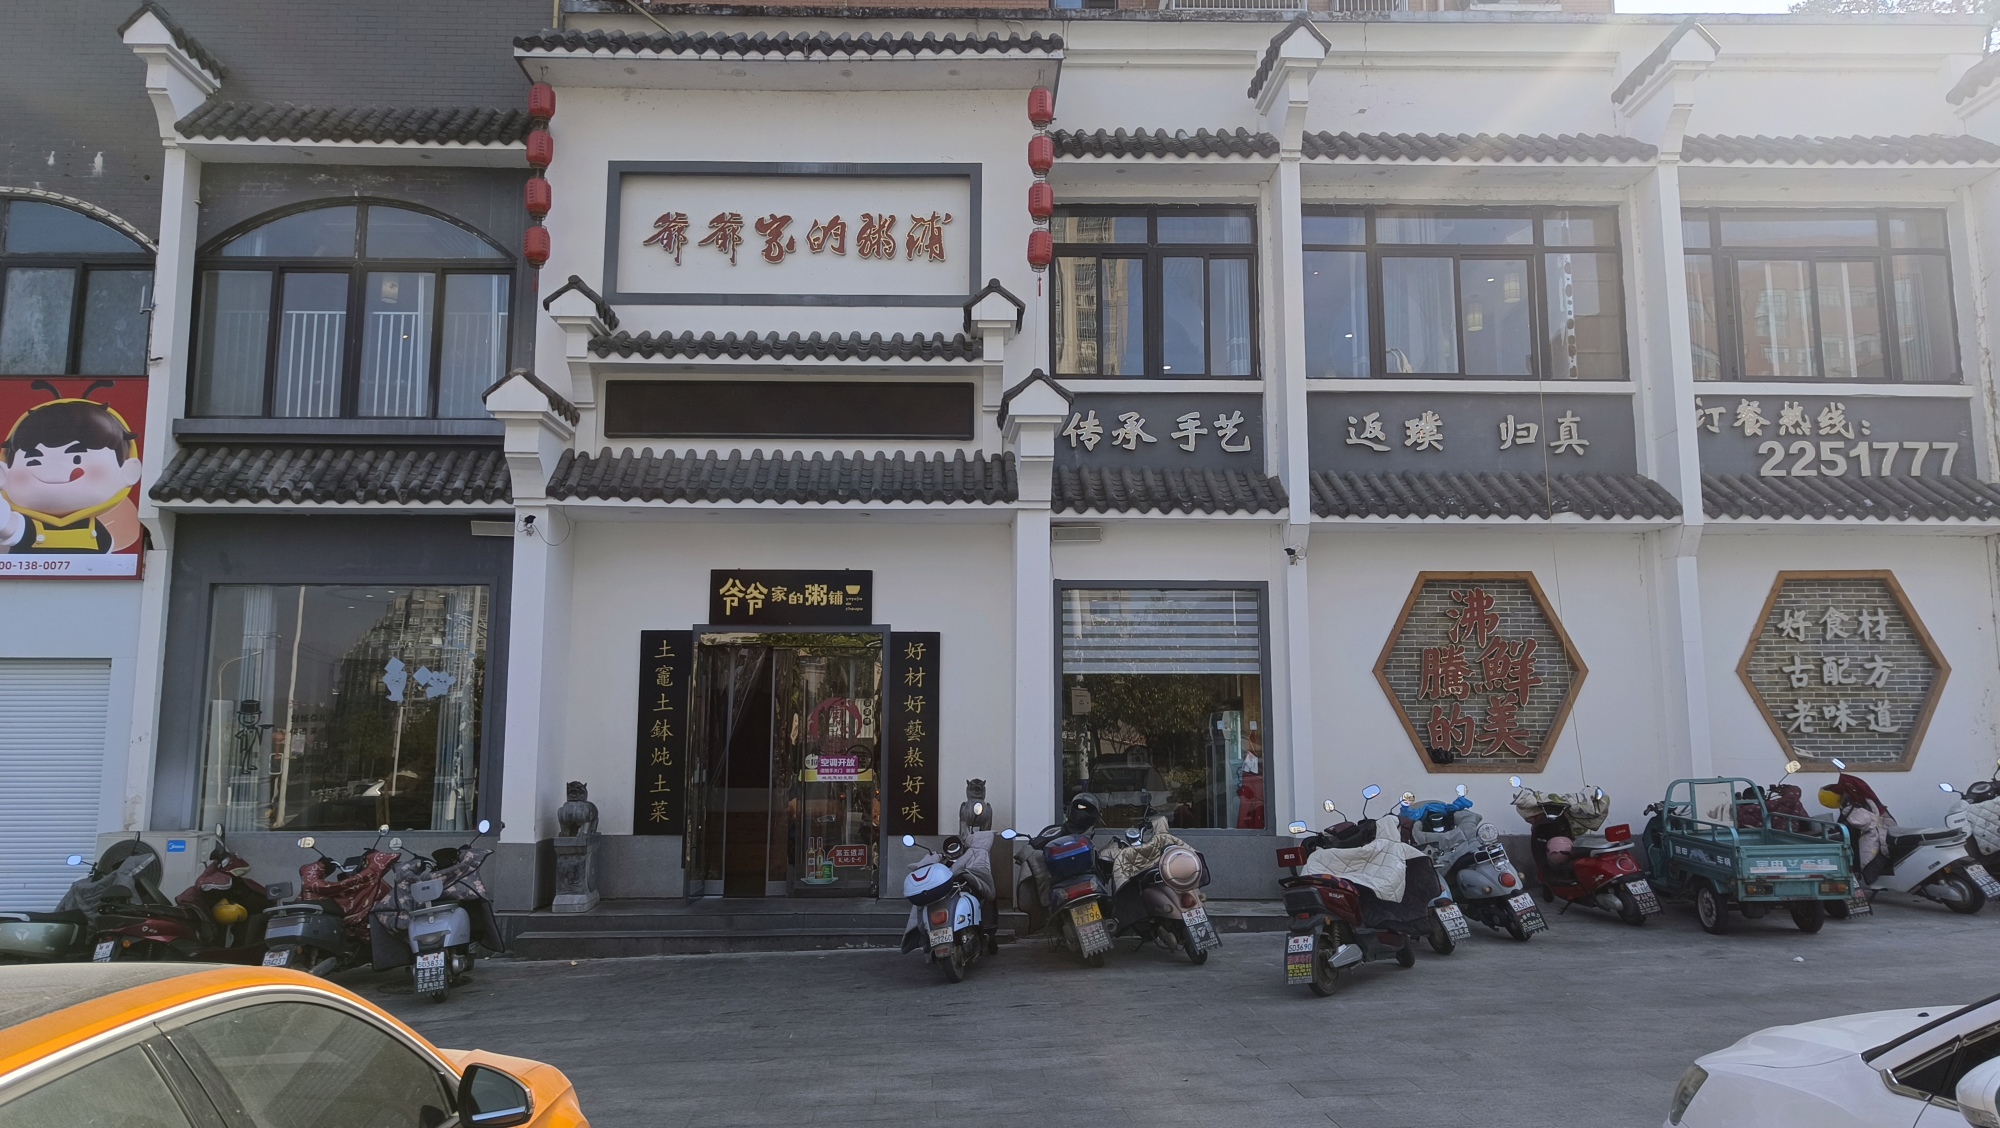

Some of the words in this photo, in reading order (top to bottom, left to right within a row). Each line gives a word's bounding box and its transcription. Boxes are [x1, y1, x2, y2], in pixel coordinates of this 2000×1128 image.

[1062, 409, 1252, 453] 传承手艺
[1500, 410, 1590, 456] 归真
[1757, 440, 1959, 477] 2251777
[719, 577, 844, 616] 爷爷家的粥铺
[1776, 606, 1890, 642] 好食材
[1781, 654, 1894, 689] 古配方
[1786, 698, 1900, 733] 老味道
[820, 758, 856, 767] 空调开放
[1074, 910, 1101, 926] ZX796
[417, 959, 444, 968] 5D3832
